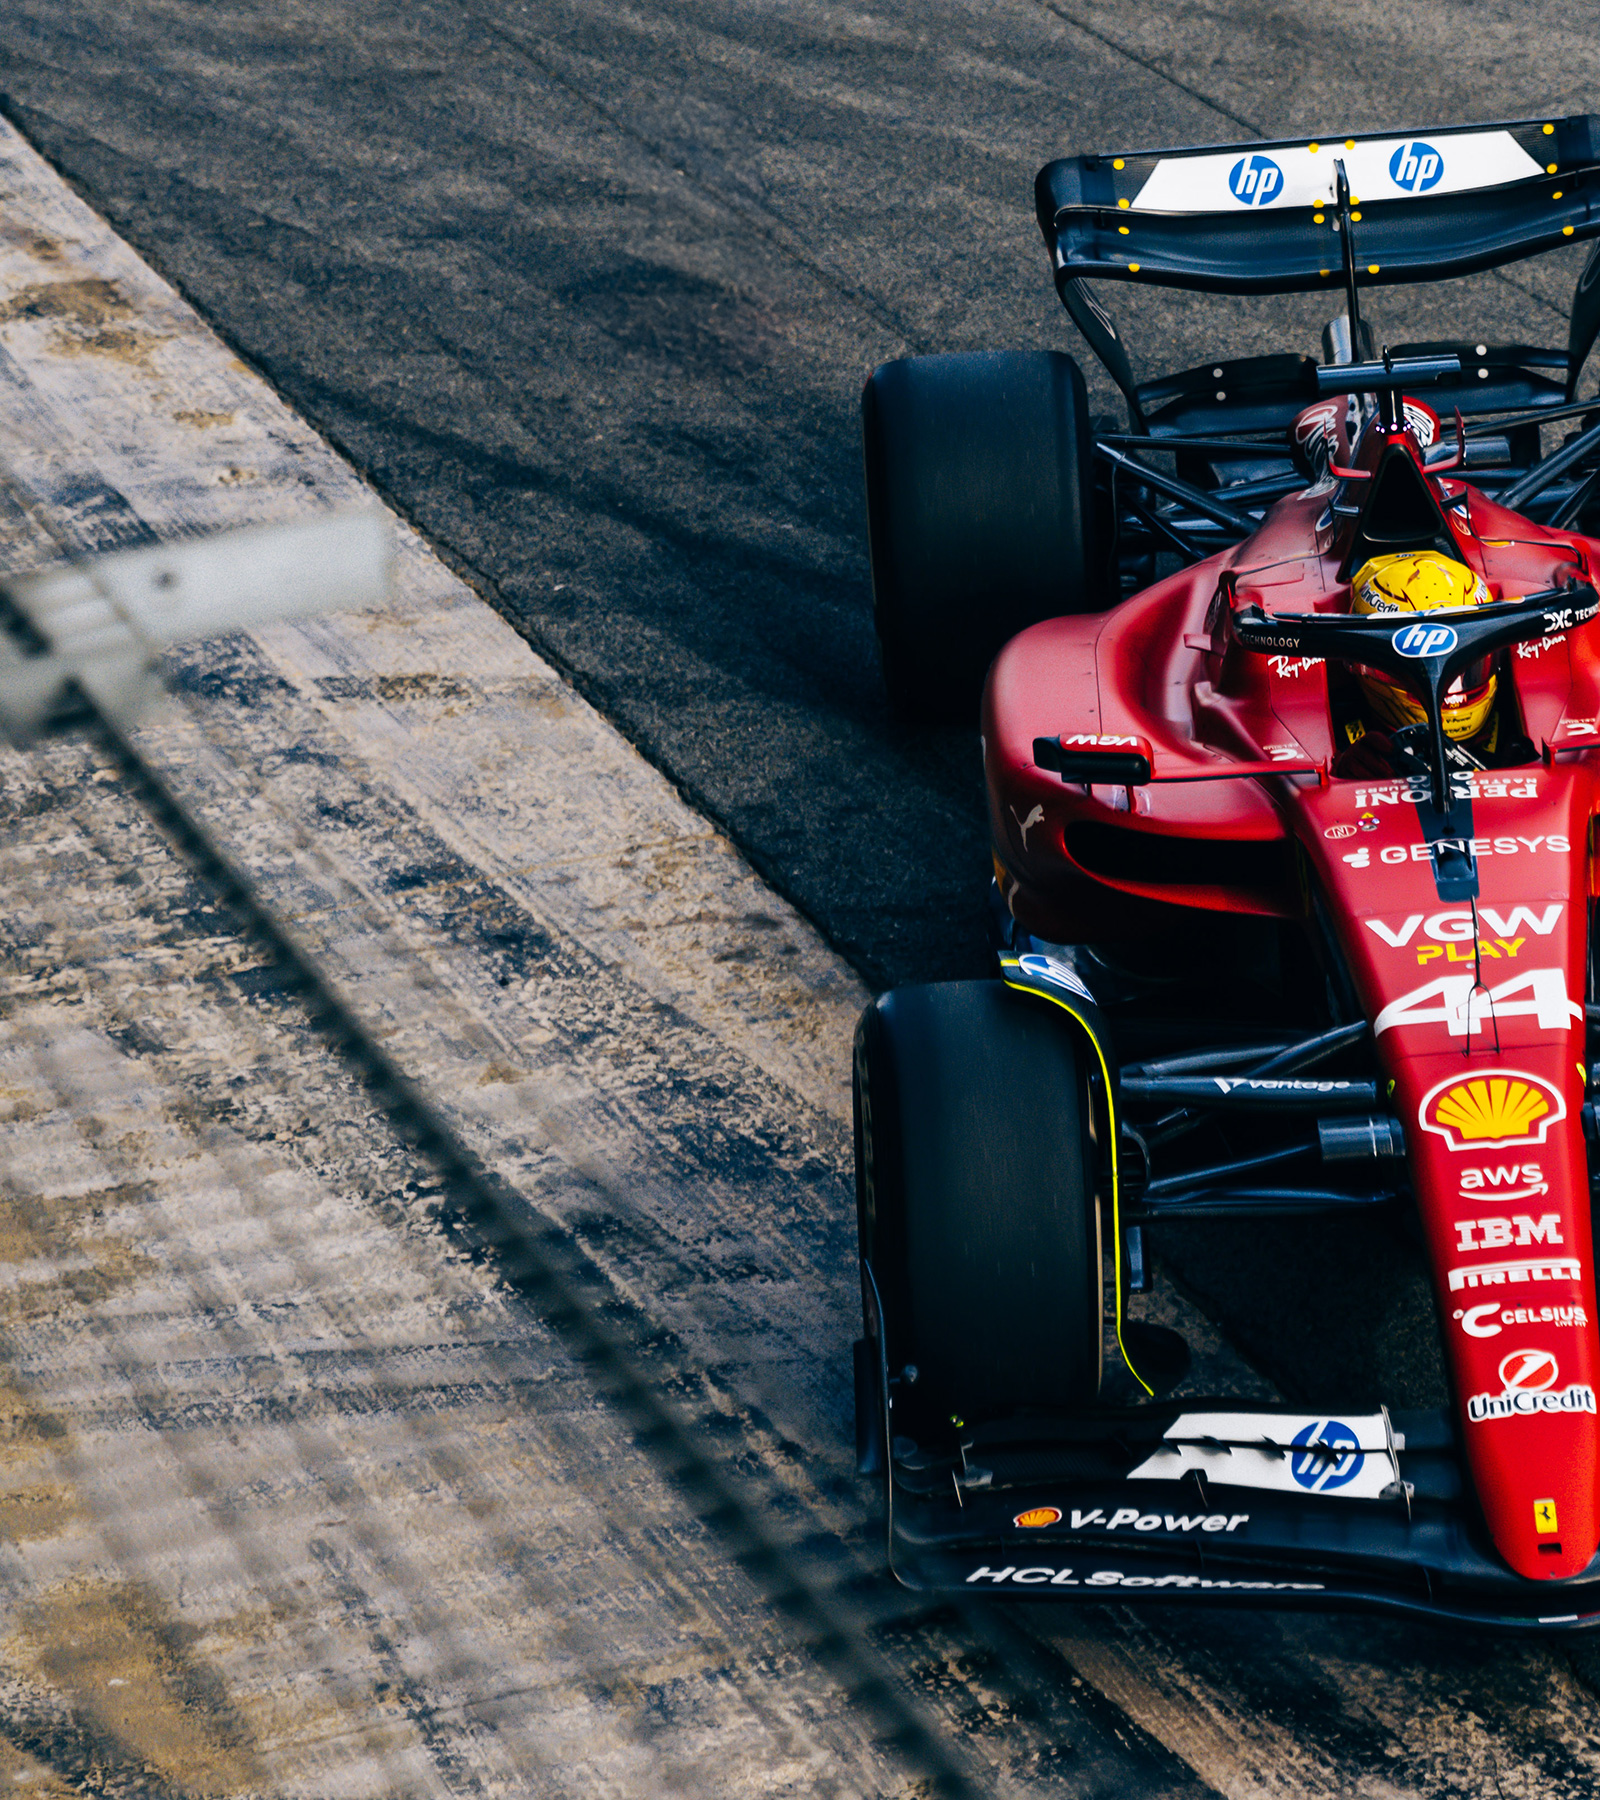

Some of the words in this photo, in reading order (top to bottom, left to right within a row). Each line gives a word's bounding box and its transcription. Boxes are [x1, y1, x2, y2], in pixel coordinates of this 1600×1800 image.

[1234, 155, 1279, 206] hp
[1395, 142, 1440, 192] hp
[1242, 633, 1300, 649] TECHNOLOGY
[1402, 624, 1450, 656] hp
[1355, 784, 1538, 808] PERONI
[1380, 835, 1571, 865] GENESYS
[1365, 904, 1564, 948] VGW
[1417, 937, 1526, 966] PLAY
[1374, 968, 1583, 1037] 44
[1248, 1079, 1351, 1092] vantage
[1460, 1163, 1544, 1189] aws
[1454, 1214, 1564, 1252] IBM
[1448, 1258, 1581, 1293] PIRELLI
[1501, 1307, 1587, 1325] CELSIUS
[1469, 1388, 1595, 1420] UniCredit
[1070, 1508, 1249, 1532] V-Power
